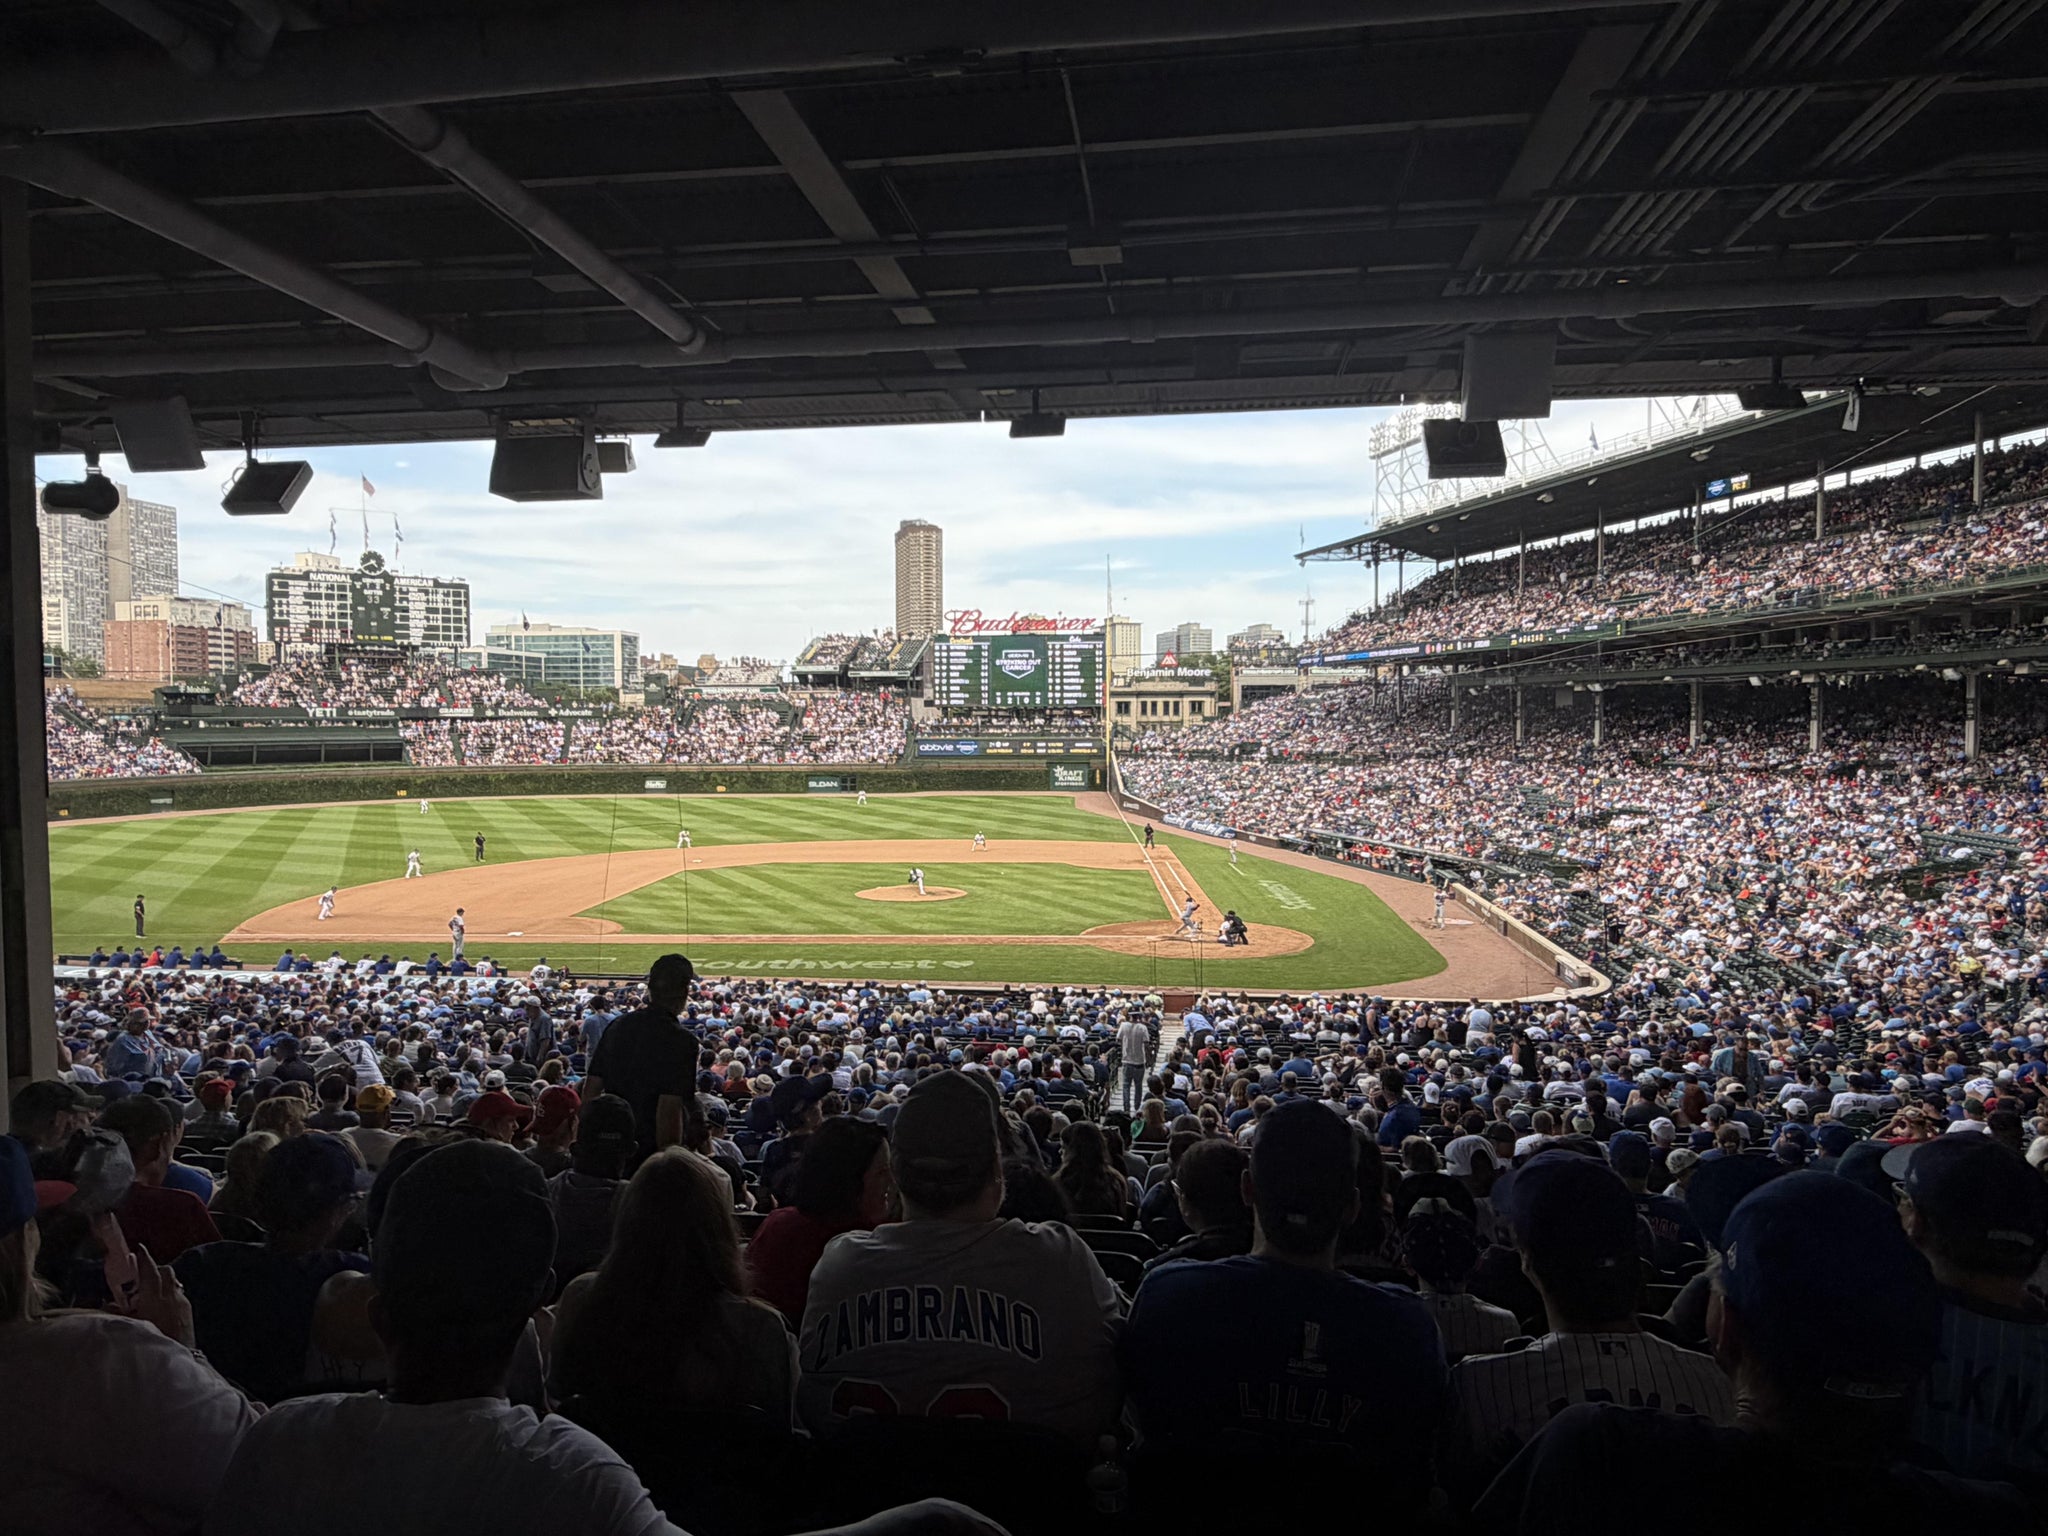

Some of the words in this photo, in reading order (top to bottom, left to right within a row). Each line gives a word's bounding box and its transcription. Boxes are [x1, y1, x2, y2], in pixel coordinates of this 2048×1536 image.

[309, 572, 352, 582] NATIONAL
[393, 577, 434, 587] AMERICAN
[944, 609, 1096, 635] Budweiser
[1126, 667, 1175, 679] Benjamin
[1177, 667, 1212, 677] Moore
[306, 708, 337, 717] YETI
[498, 708, 538, 717] Budweiser
[558, 708, 593, 717] Advocate
[919, 743, 954, 751] abbvie
[808, 780, 838, 788] SLOAN
[814, 1283, 1043, 1371] ZAMBRANO
[1237, 1381, 1363, 1433] LILLY
